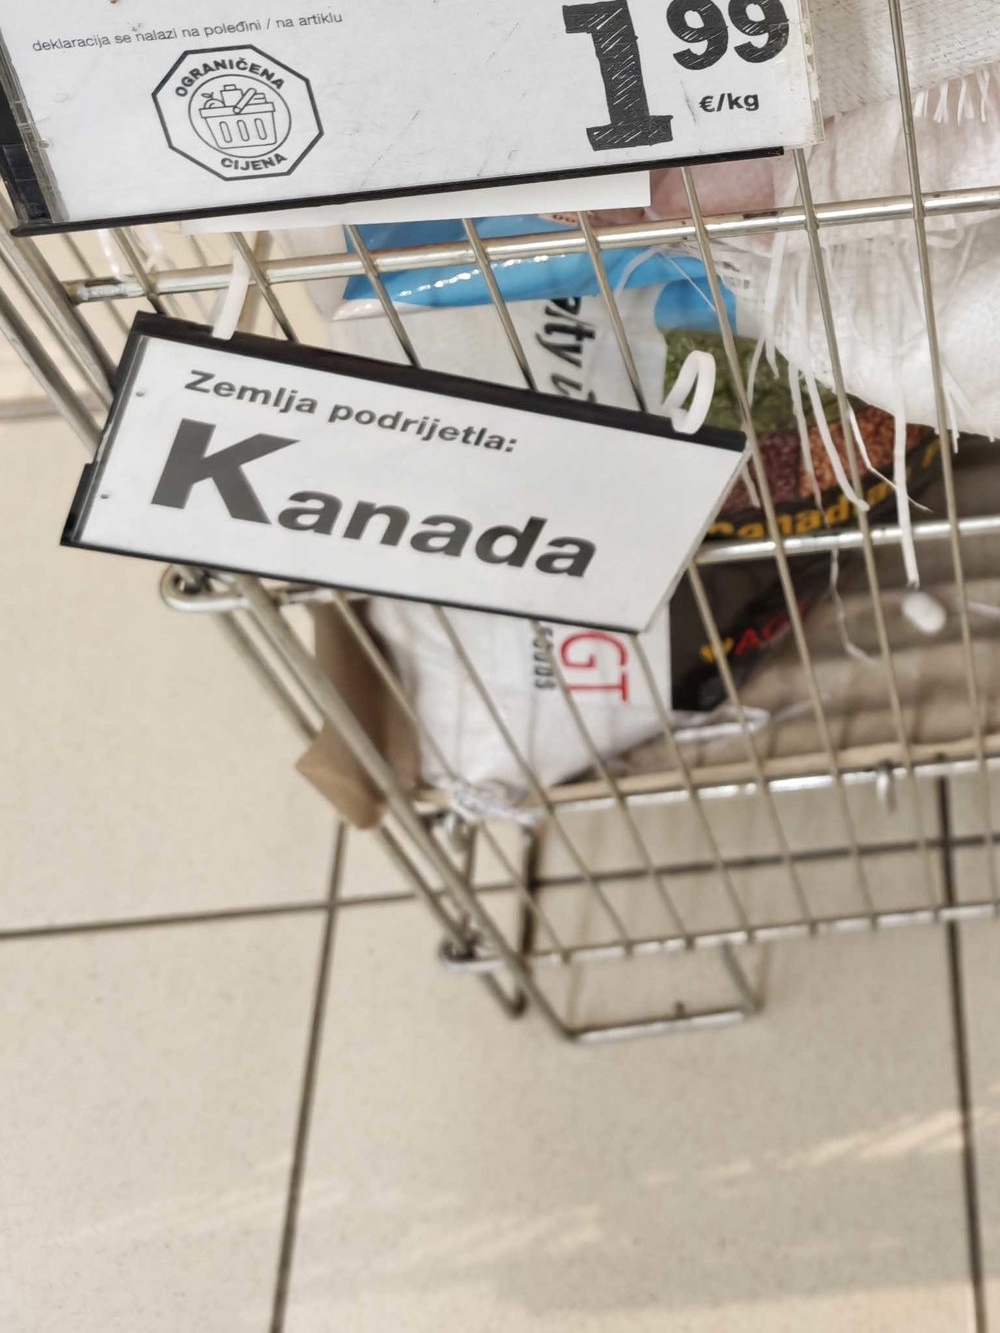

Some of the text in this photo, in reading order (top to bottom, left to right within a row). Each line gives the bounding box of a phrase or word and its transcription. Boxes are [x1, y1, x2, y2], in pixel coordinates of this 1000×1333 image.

[33, 33, 111, 52] deklaracija
[114, 32, 132, 45] se
[135, 27, 177, 43] nalazi
[182, 26, 200, 38] na
[204, 19, 262, 39] poleđini
[276, 17, 294, 28] na
[299, 12, 343, 27] artiklu
[175, 57, 285, 97] OGRANIČENA
[562, 0, 673, 151] 1
[699, 92, 759, 113] €/kg
[221, 153, 288, 171] CIJENA
[184, 369, 518, 454] Zemlja podrijetla:
[150, 418, 597, 578] Kanada
